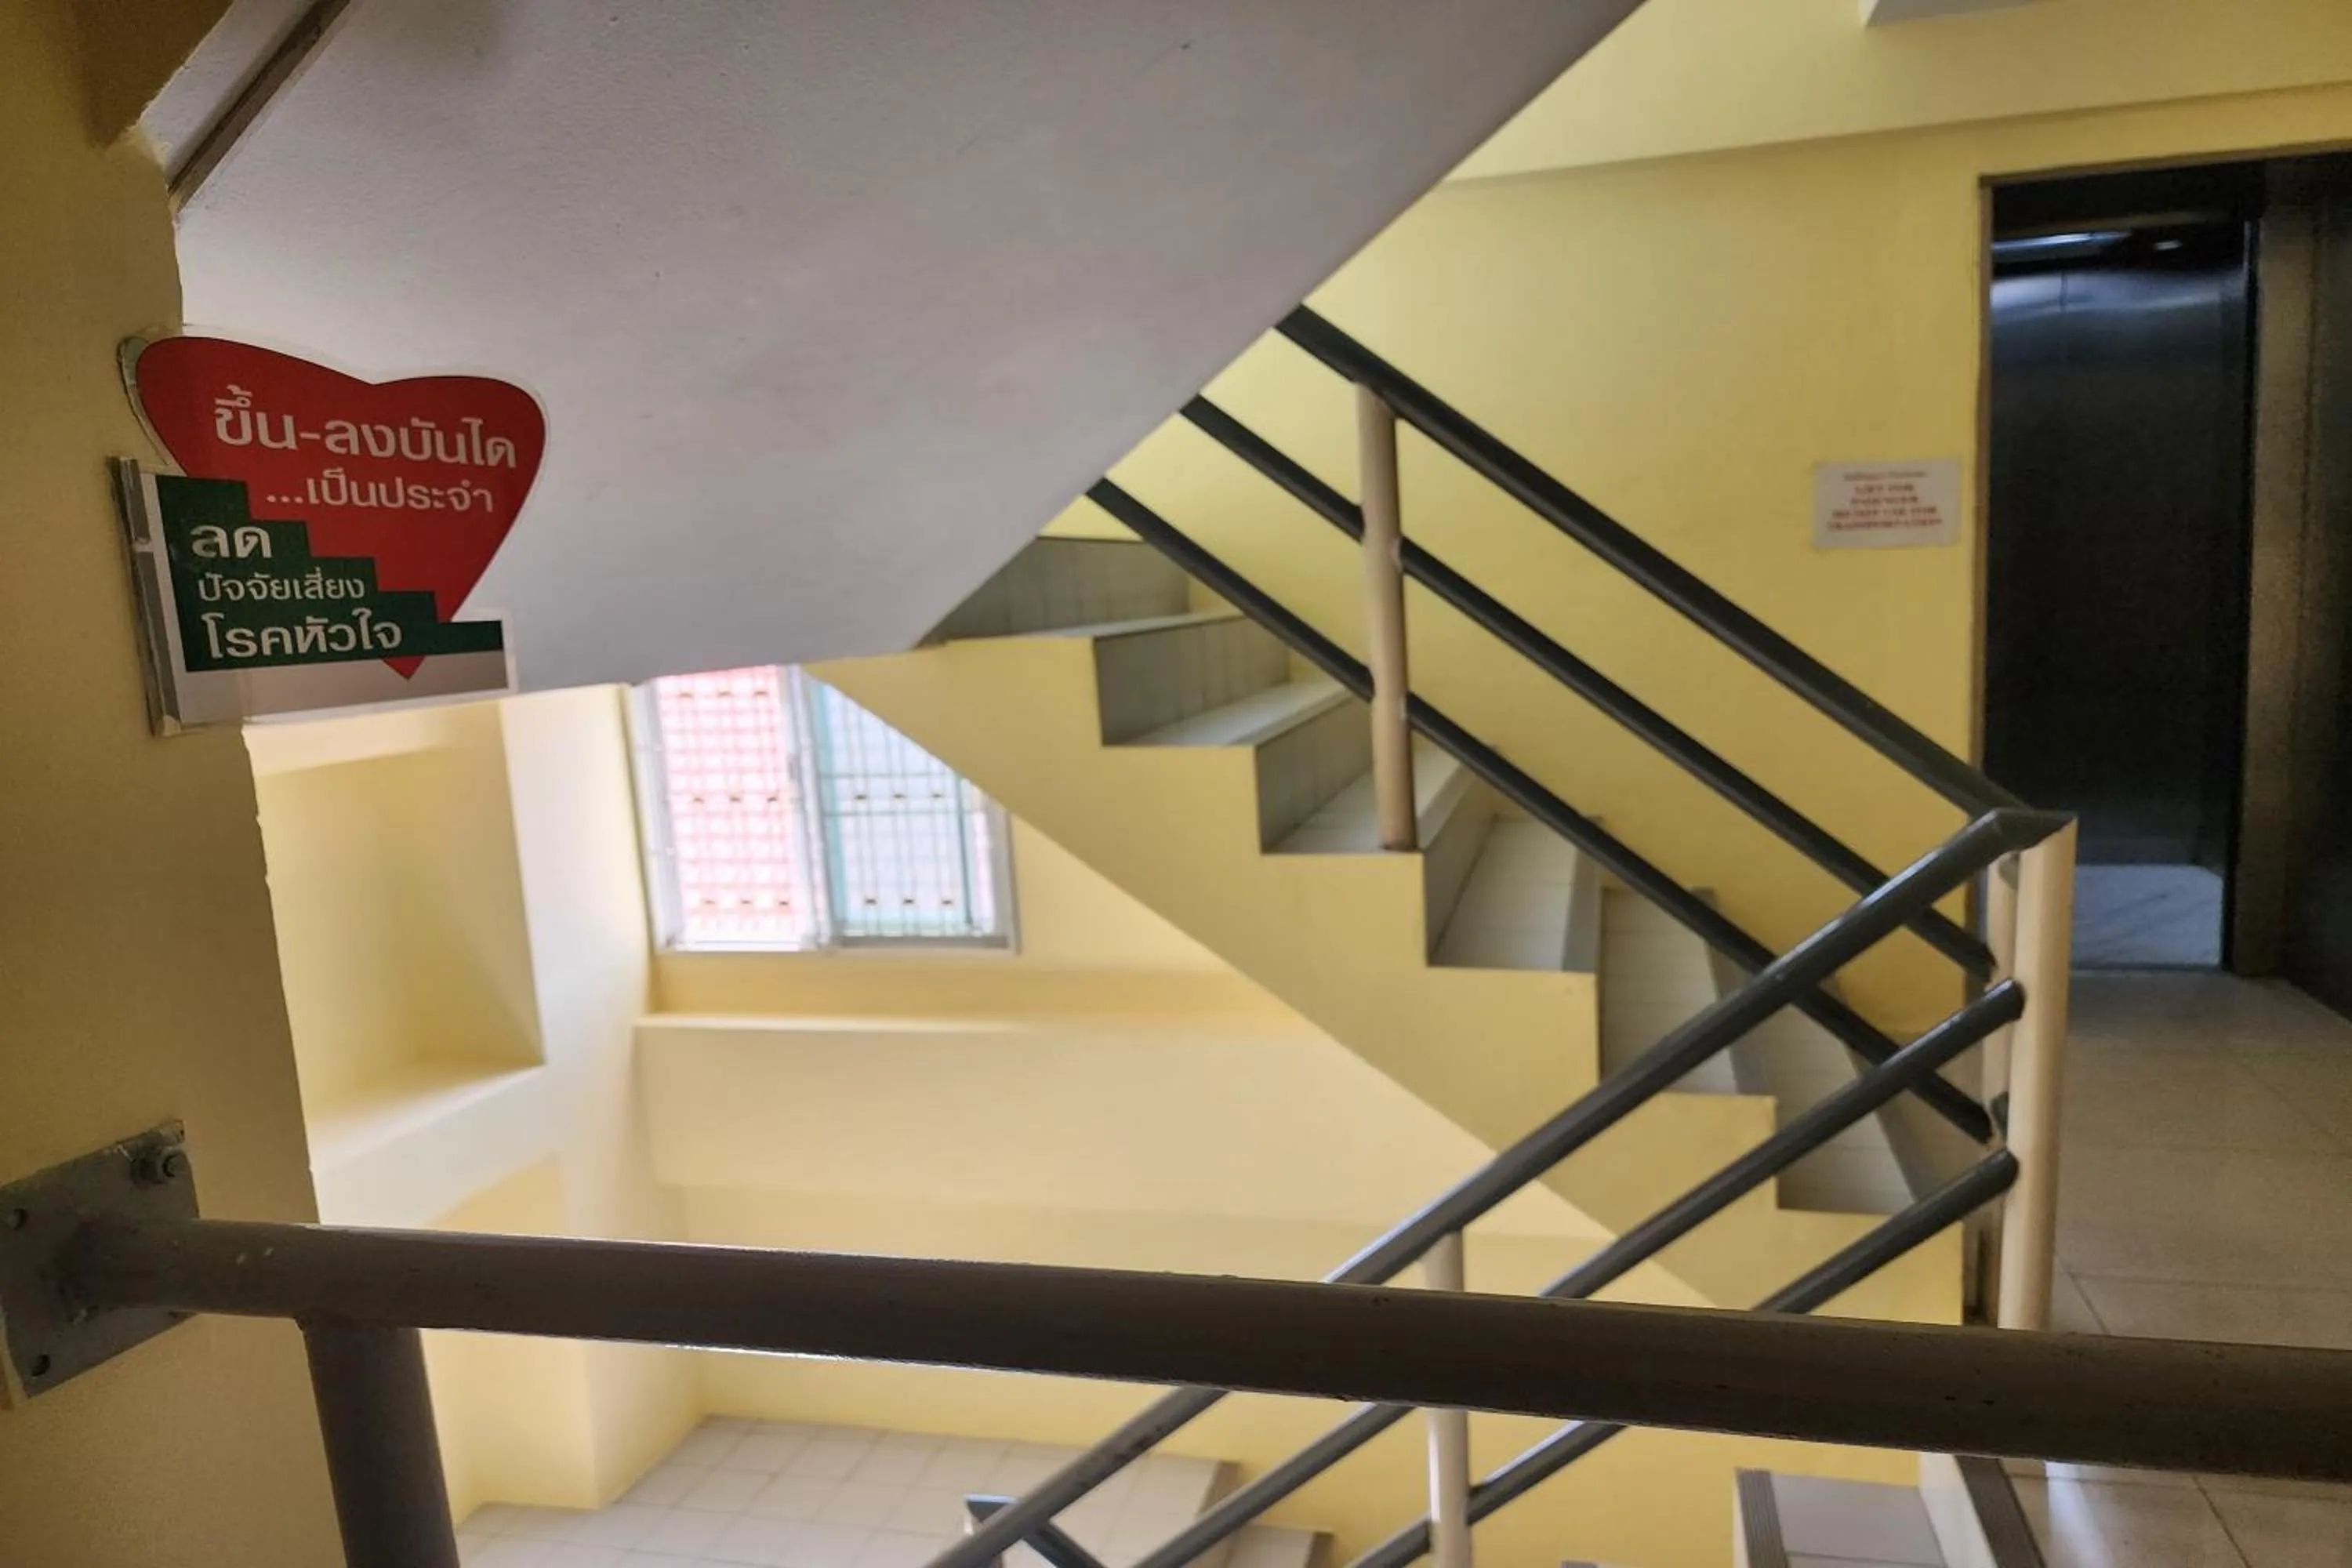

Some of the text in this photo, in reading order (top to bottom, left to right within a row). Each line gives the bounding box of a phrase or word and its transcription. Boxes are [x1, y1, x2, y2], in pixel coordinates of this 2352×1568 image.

[215, 384, 516, 467] ขึ้น-ลงบันได
[267, 466, 492, 512] ...เป็นประจำ
[191, 524, 273, 559] ลด
[198, 566, 365, 602] ปัจจัยเสี่ยง
[201, 607, 402, 659] โรคหัวใจ
